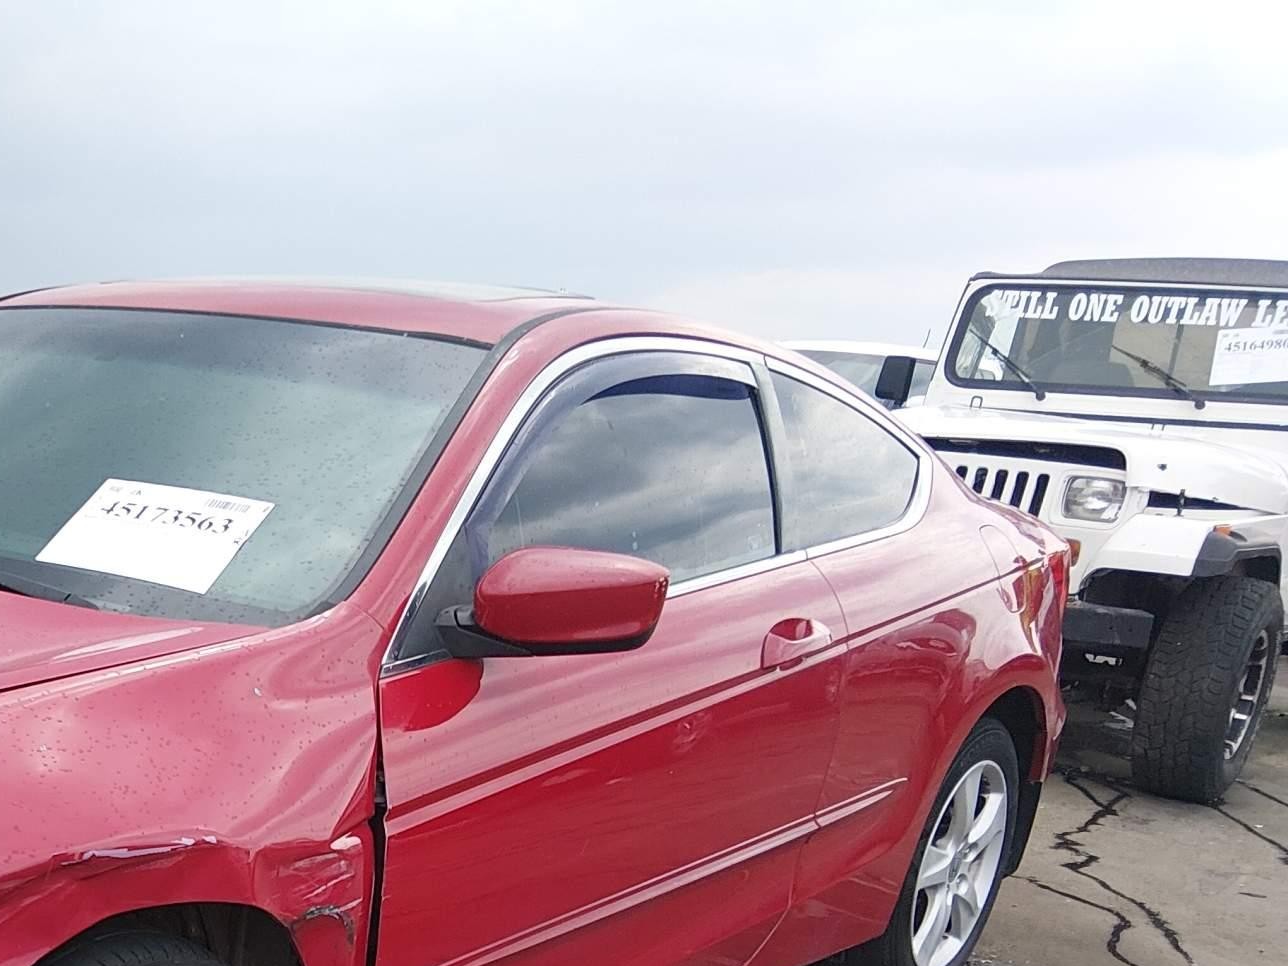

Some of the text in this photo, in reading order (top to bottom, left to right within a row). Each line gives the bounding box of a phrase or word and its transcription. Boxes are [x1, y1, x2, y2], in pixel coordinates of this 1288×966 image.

[1068, 292, 1124, 322] ONE
[1130, 295, 1249, 327] OUTLAW
[101, 501, 234, 534] 45173563
